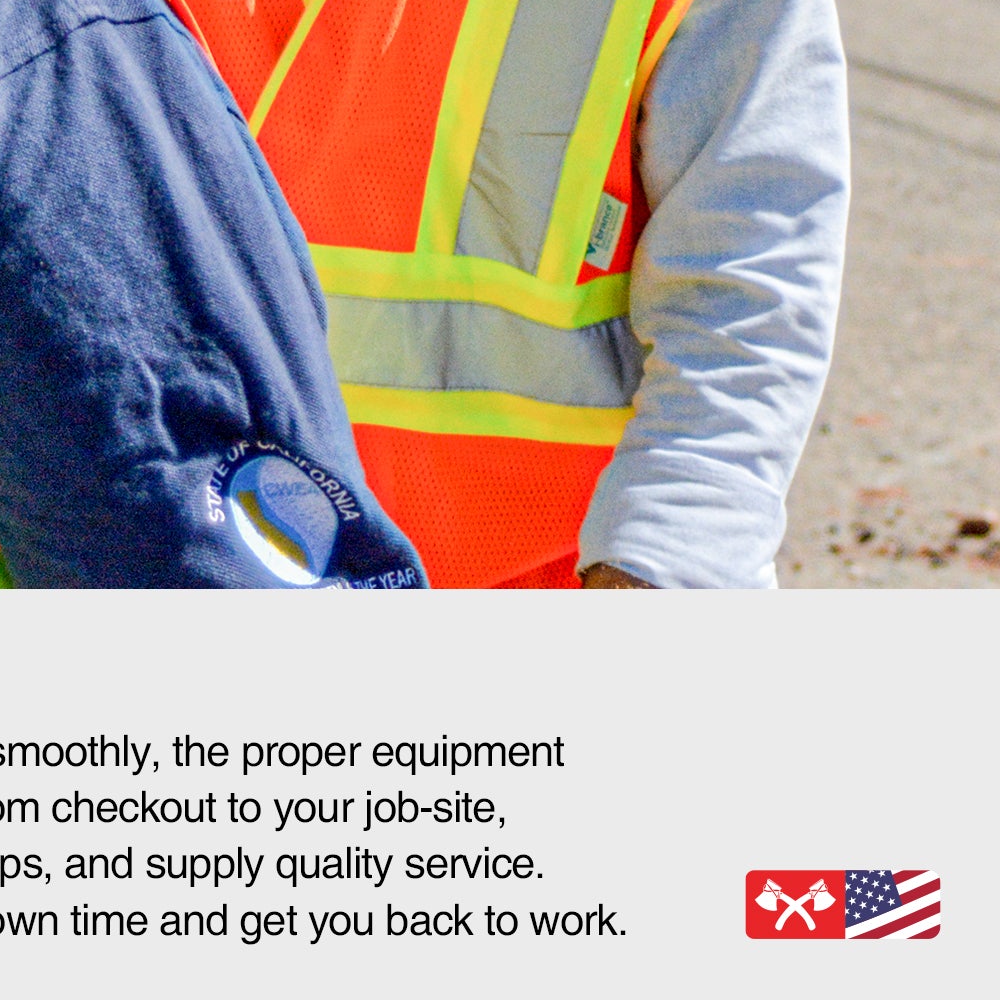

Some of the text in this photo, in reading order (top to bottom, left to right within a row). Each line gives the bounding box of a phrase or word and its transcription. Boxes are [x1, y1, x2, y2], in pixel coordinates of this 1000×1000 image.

[206, 463, 230, 523] STATE
[257, 440, 361, 521] CORNIA
[379, 567, 417, 590] YEAR
